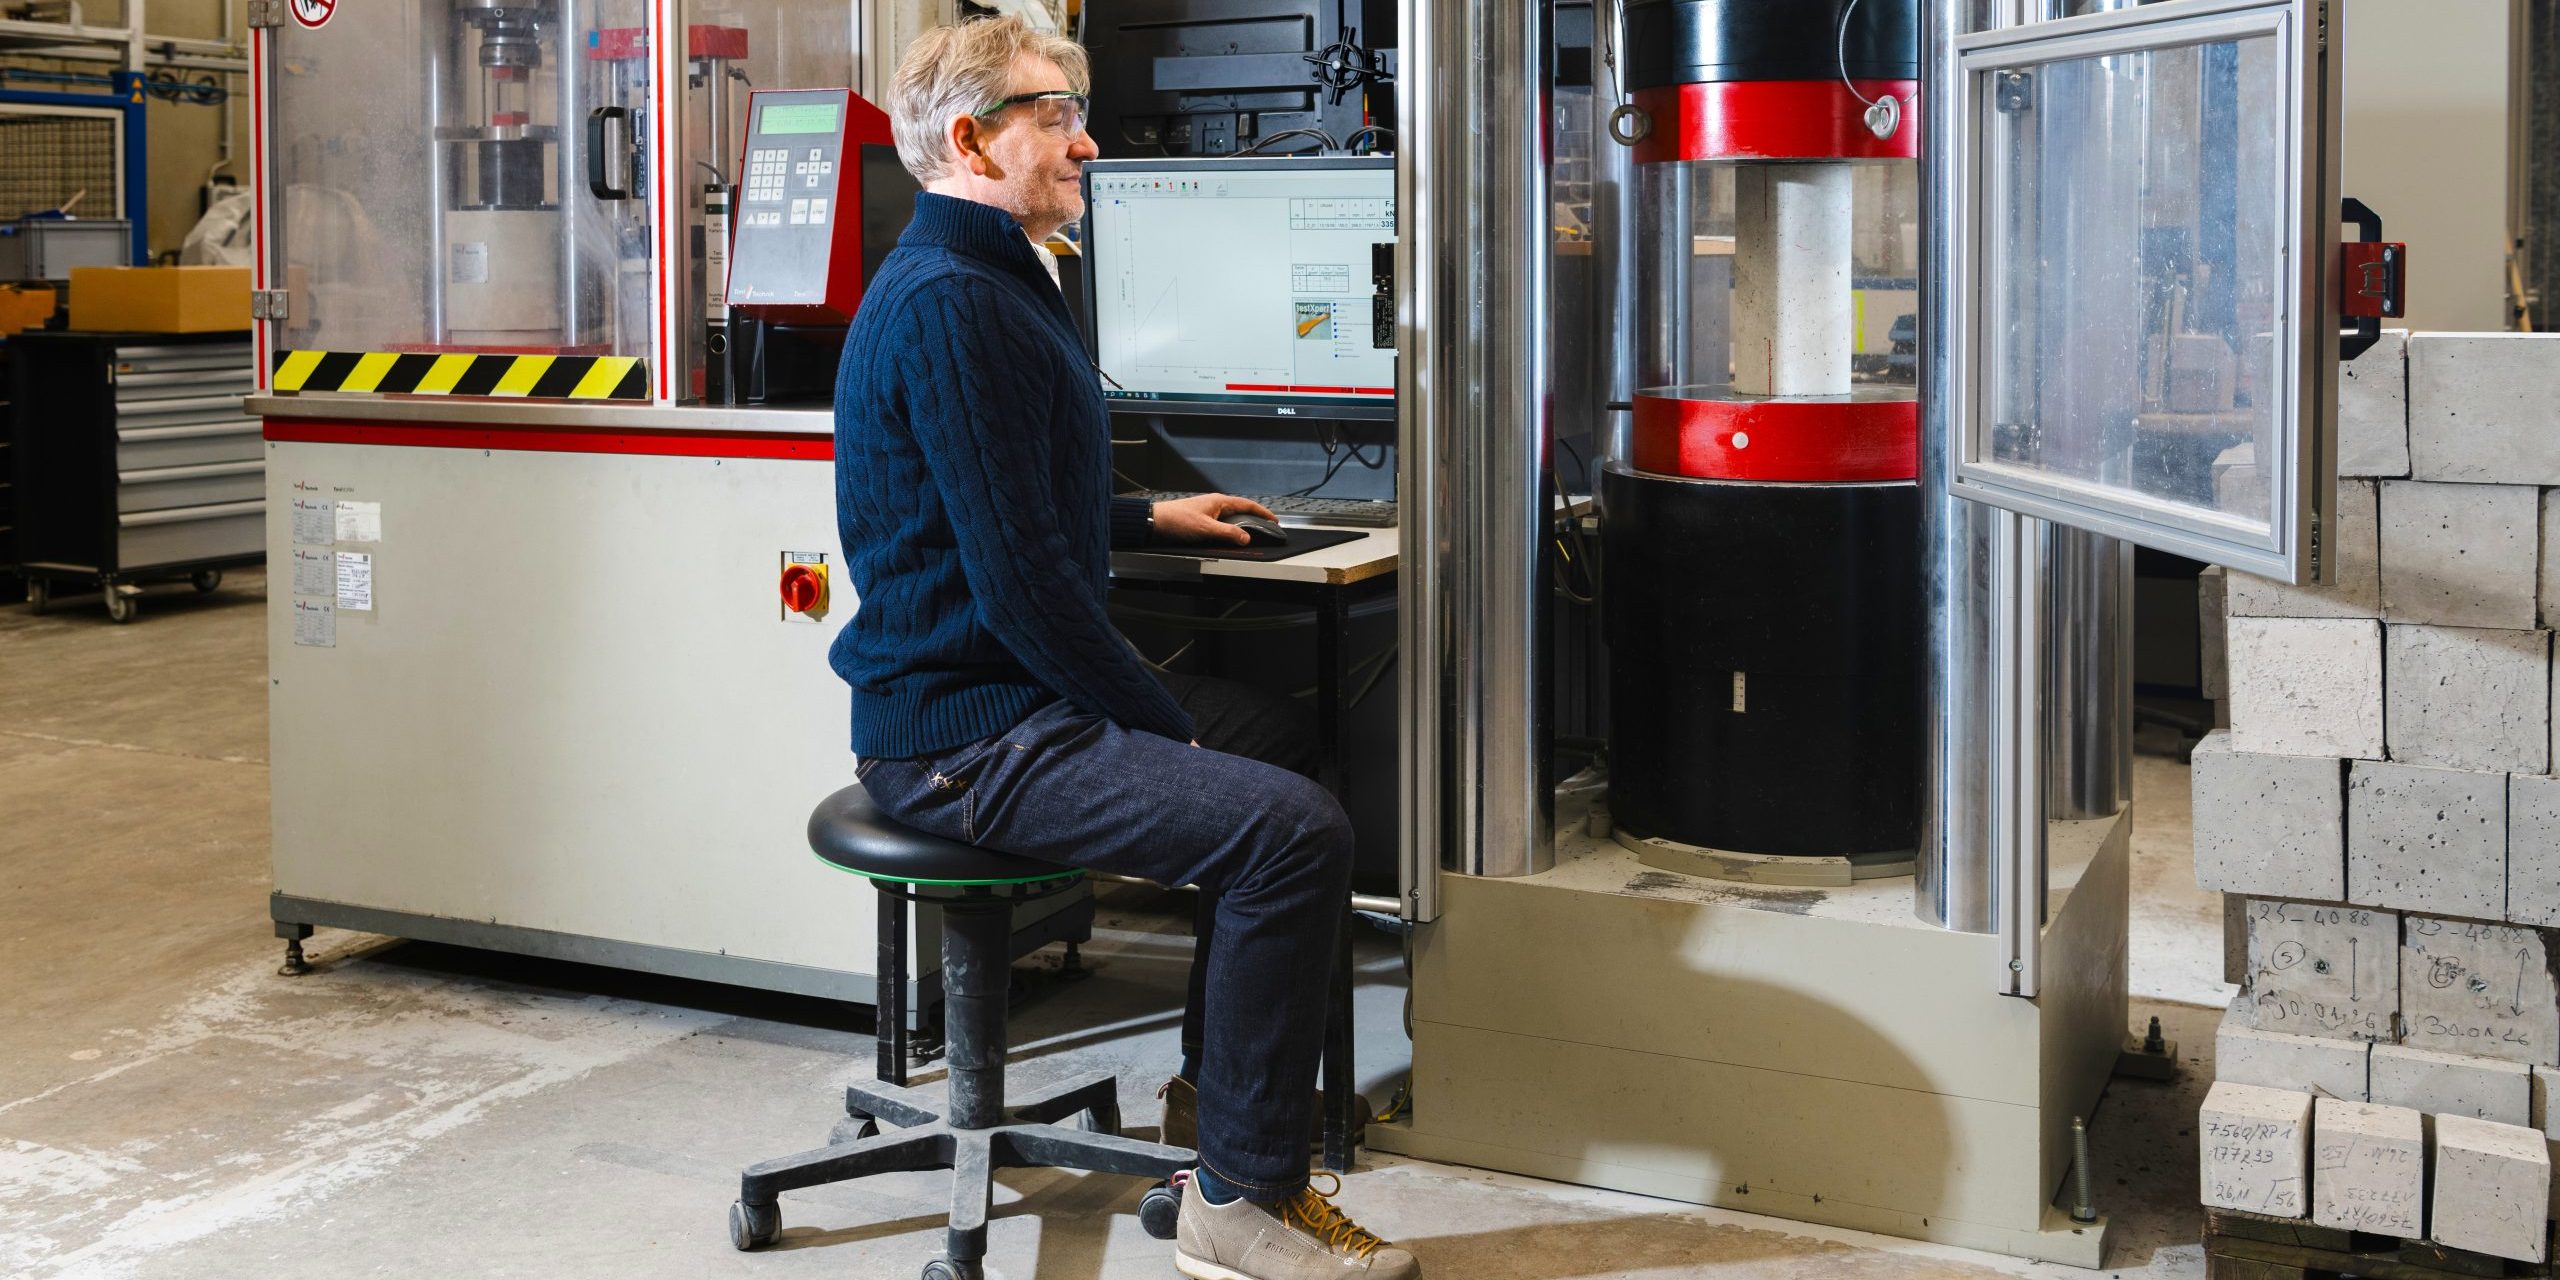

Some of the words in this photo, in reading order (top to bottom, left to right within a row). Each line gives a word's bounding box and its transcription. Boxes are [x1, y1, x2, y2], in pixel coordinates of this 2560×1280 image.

[1296, 303, 1330, 313] testXpert
[1277, 407, 1296, 415] DELL
[2209, 1146, 2274, 1164] 177233
